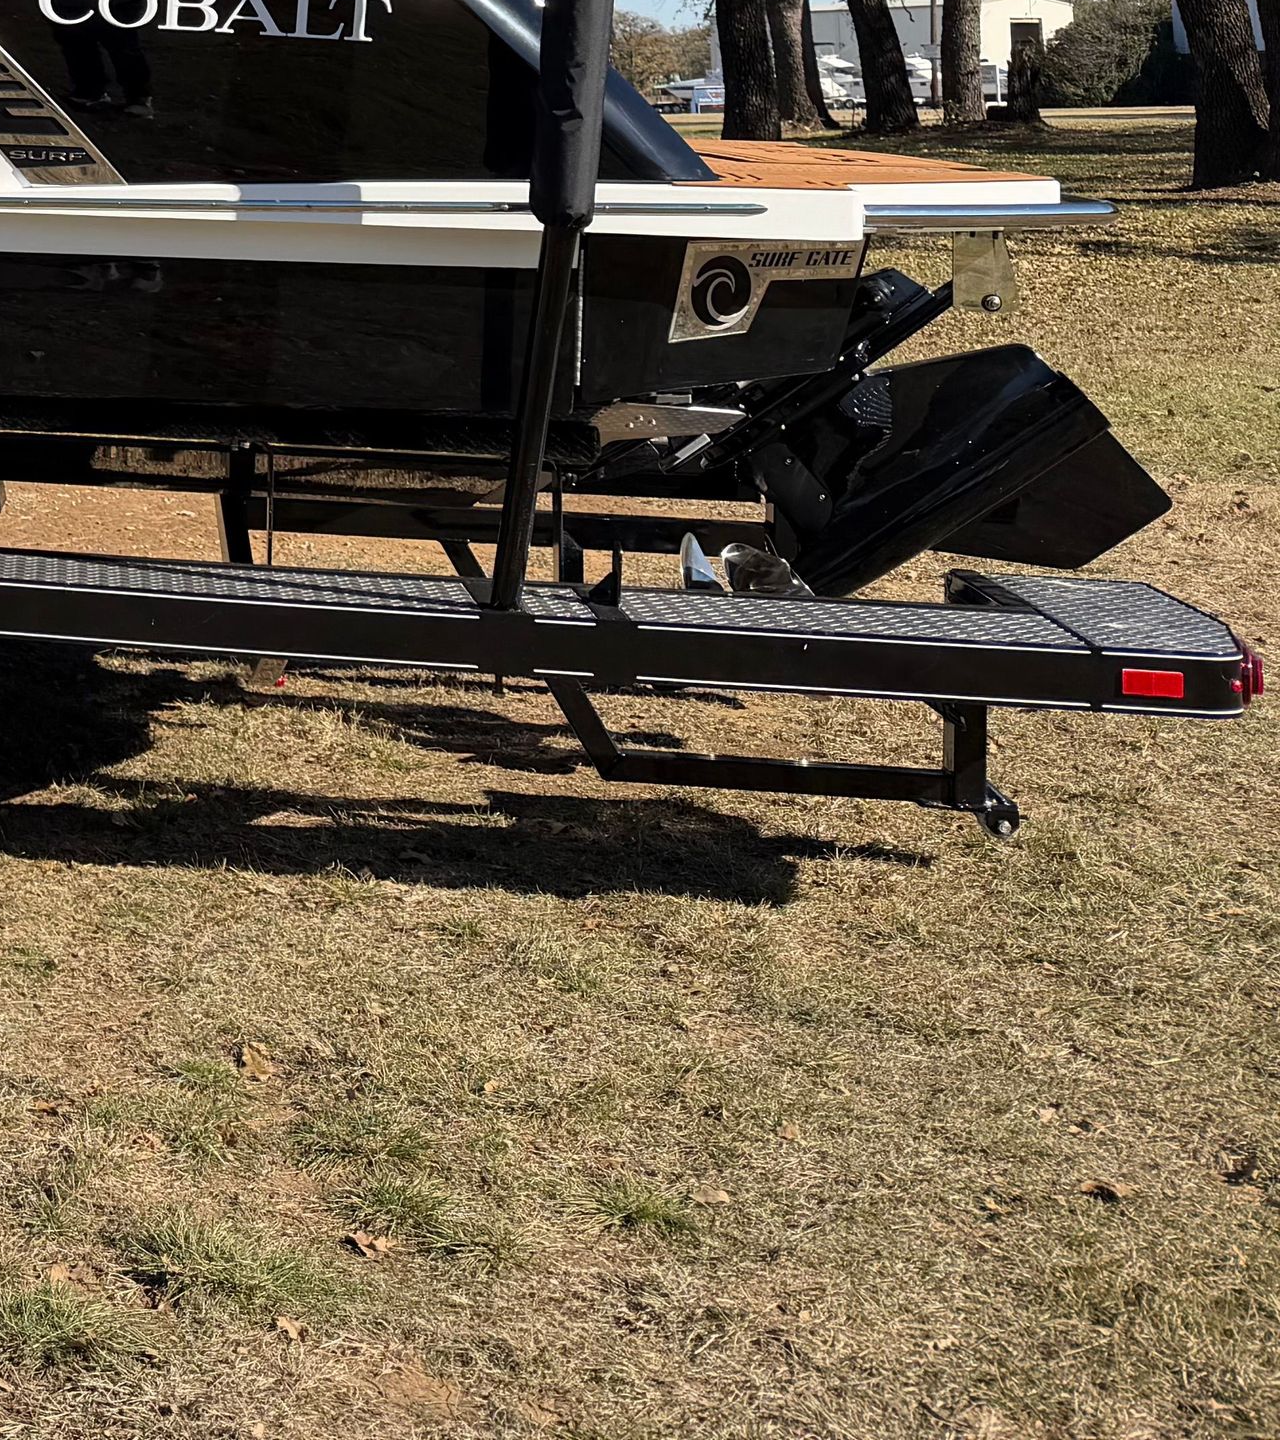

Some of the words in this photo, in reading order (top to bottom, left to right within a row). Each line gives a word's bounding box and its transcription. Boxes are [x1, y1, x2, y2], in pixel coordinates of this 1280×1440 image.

[8, 150, 86, 162] SURF
[748, 251, 803, 268] SURF
[805, 250, 856, 267] GATE
